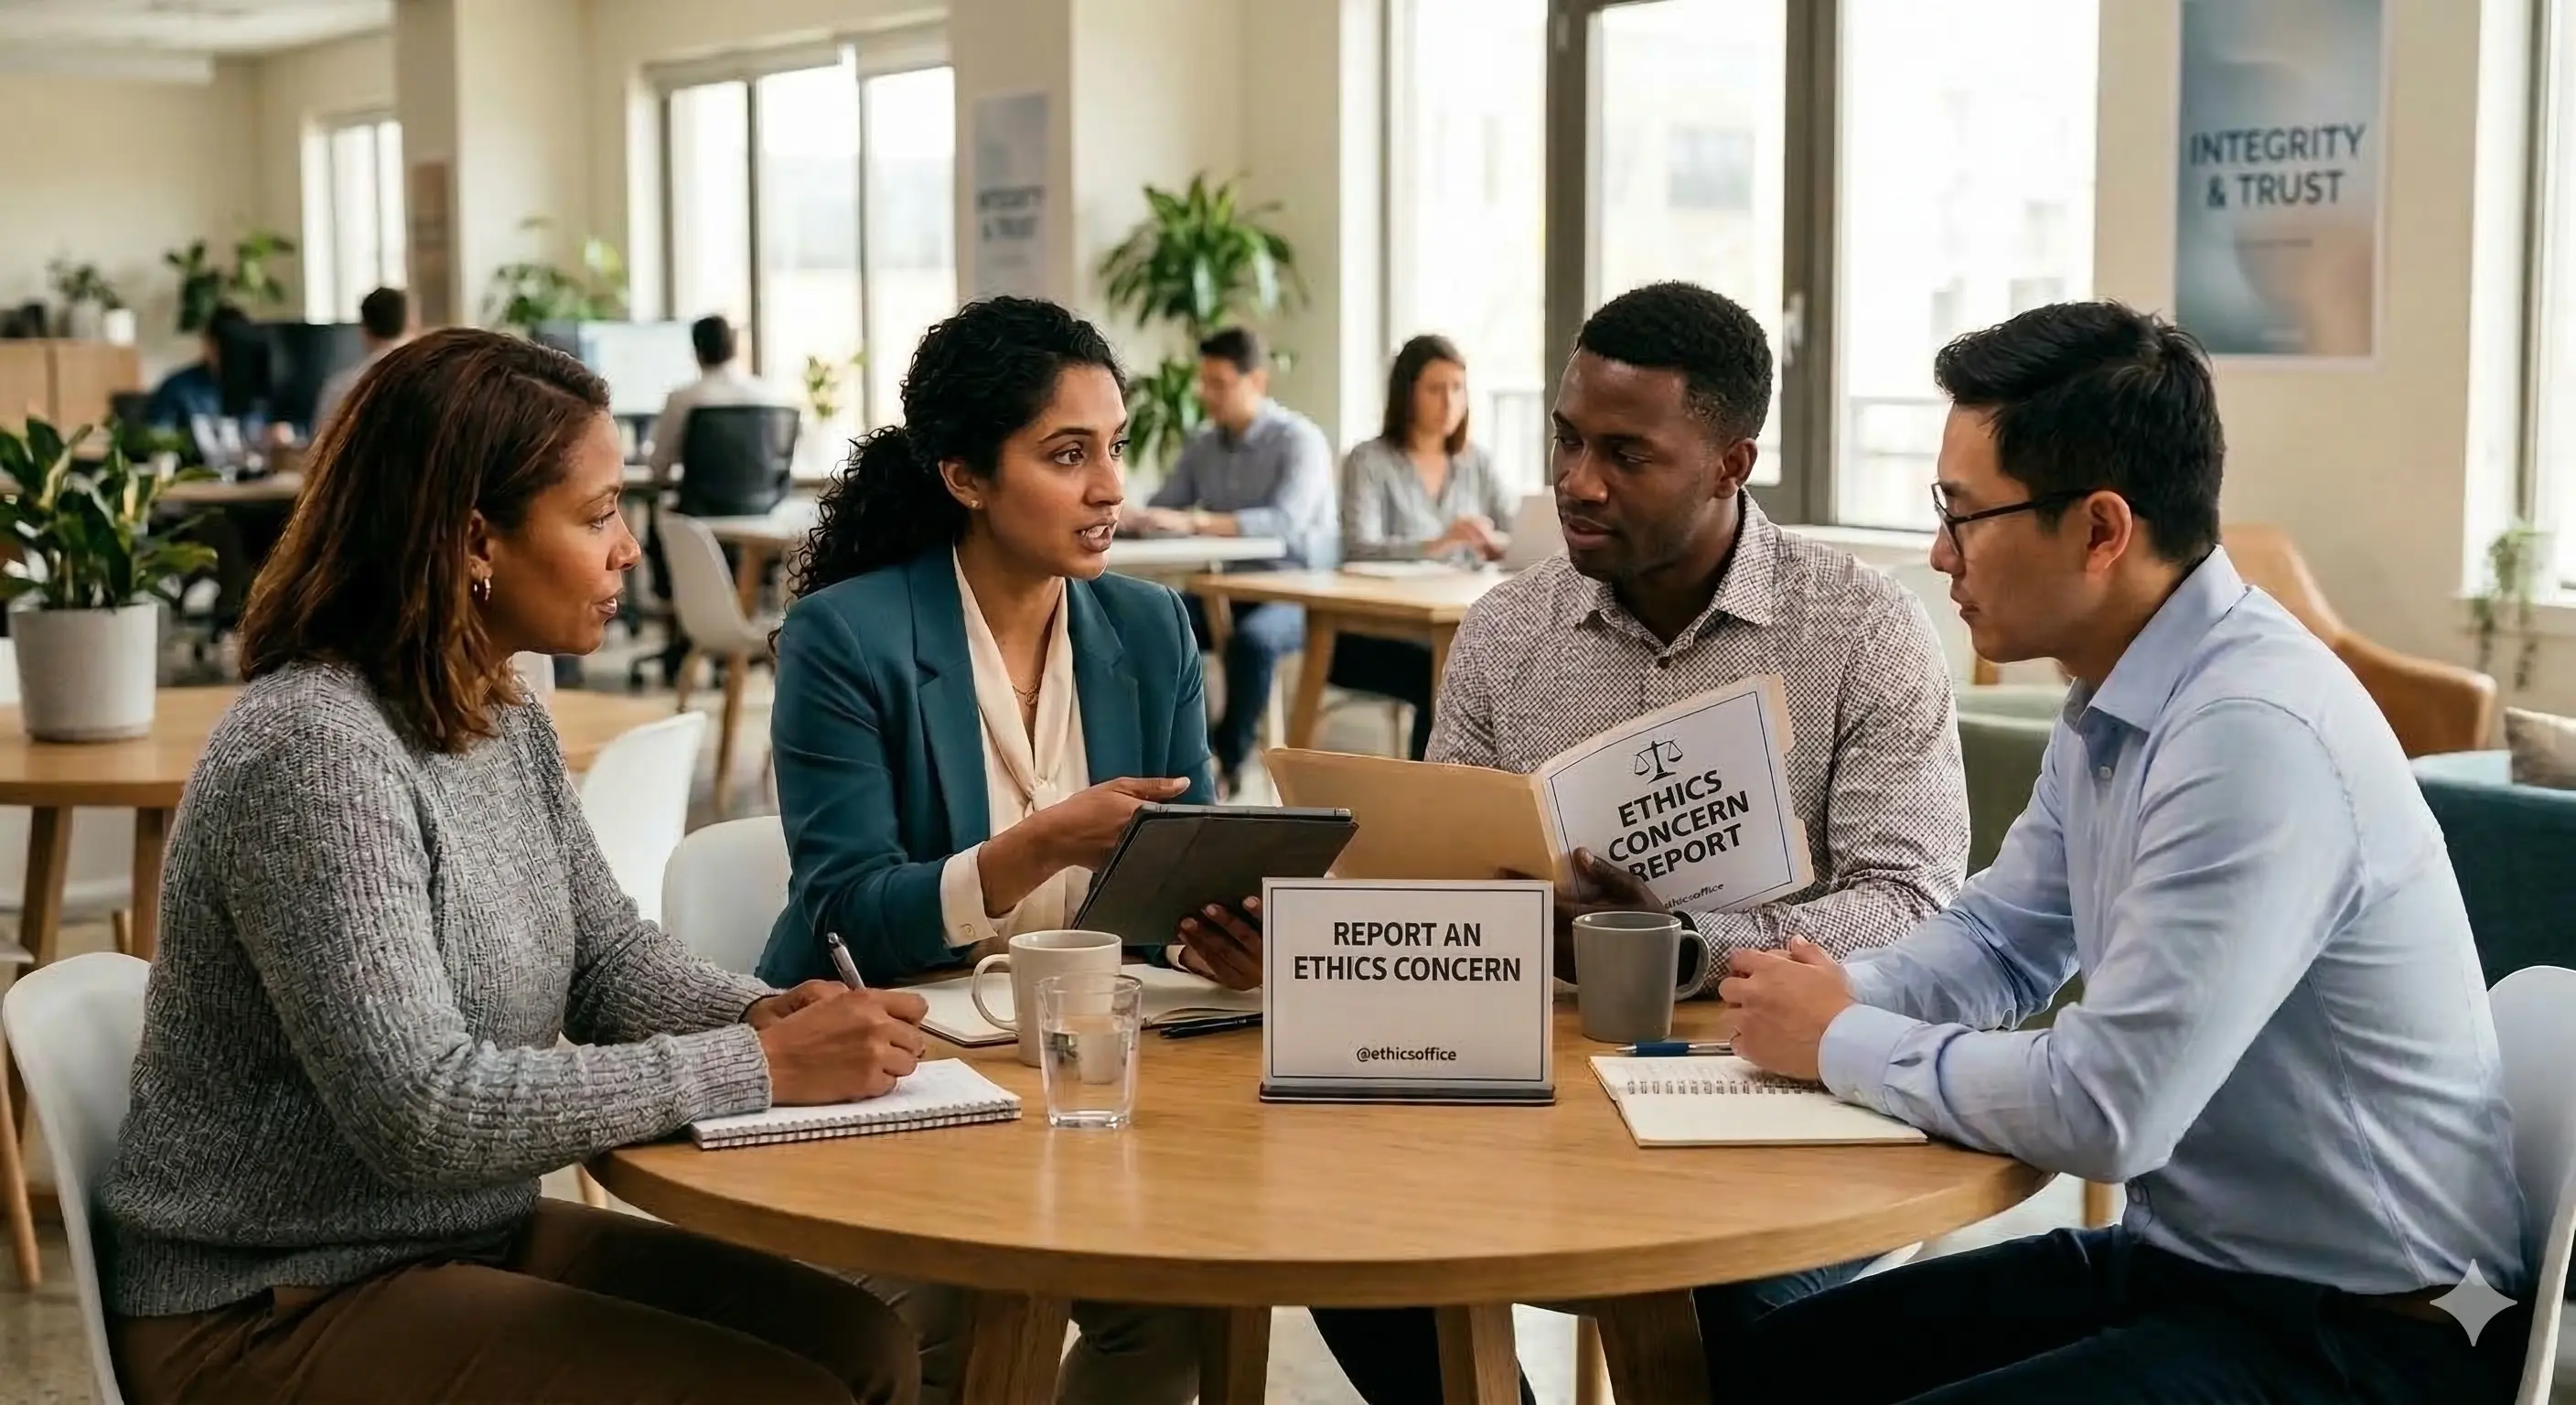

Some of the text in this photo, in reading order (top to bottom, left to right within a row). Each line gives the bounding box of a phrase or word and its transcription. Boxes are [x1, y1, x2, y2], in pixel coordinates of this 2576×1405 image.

[2190, 123, 2366, 166] INTEGRITY
[2206, 169, 2345, 209] & TRUST
[1618, 769, 1723, 828] ETHICS
[1608, 790, 1750, 863] CONCERN
[1628, 823, 1742, 883] REPORT
[1334, 922, 1481, 947] REPORT AN
[1294, 956, 1521, 981] ETHICS CONCERN
[1356, 1046, 1457, 1063] @ethicsoffice
